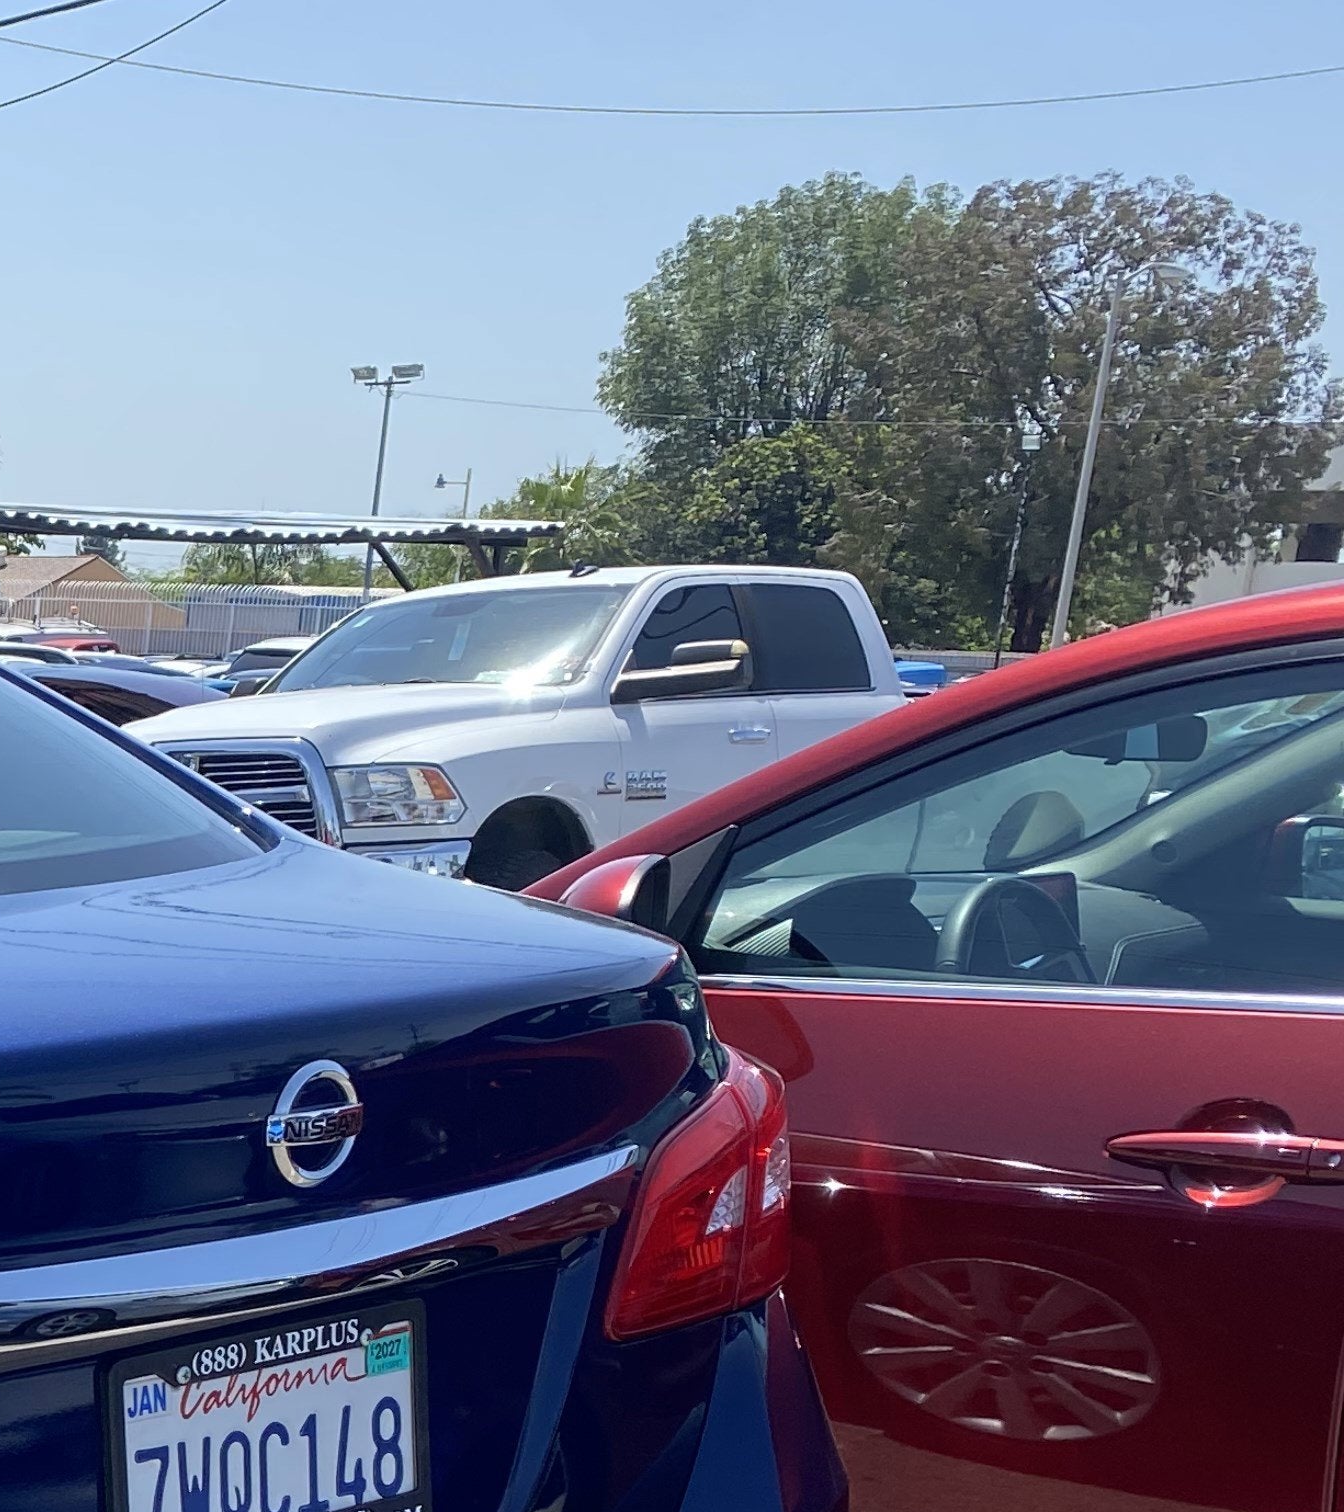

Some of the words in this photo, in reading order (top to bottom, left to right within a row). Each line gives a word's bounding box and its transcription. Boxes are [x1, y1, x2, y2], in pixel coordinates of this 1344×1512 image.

[127, 1383, 167, 1418] JAN
[179, 1355, 368, 1423] California
[375, 1338, 401, 1360] 2027
[191, 1341, 247, 1377] (888)
[253, 1318, 359, 1365] KARPLUS
